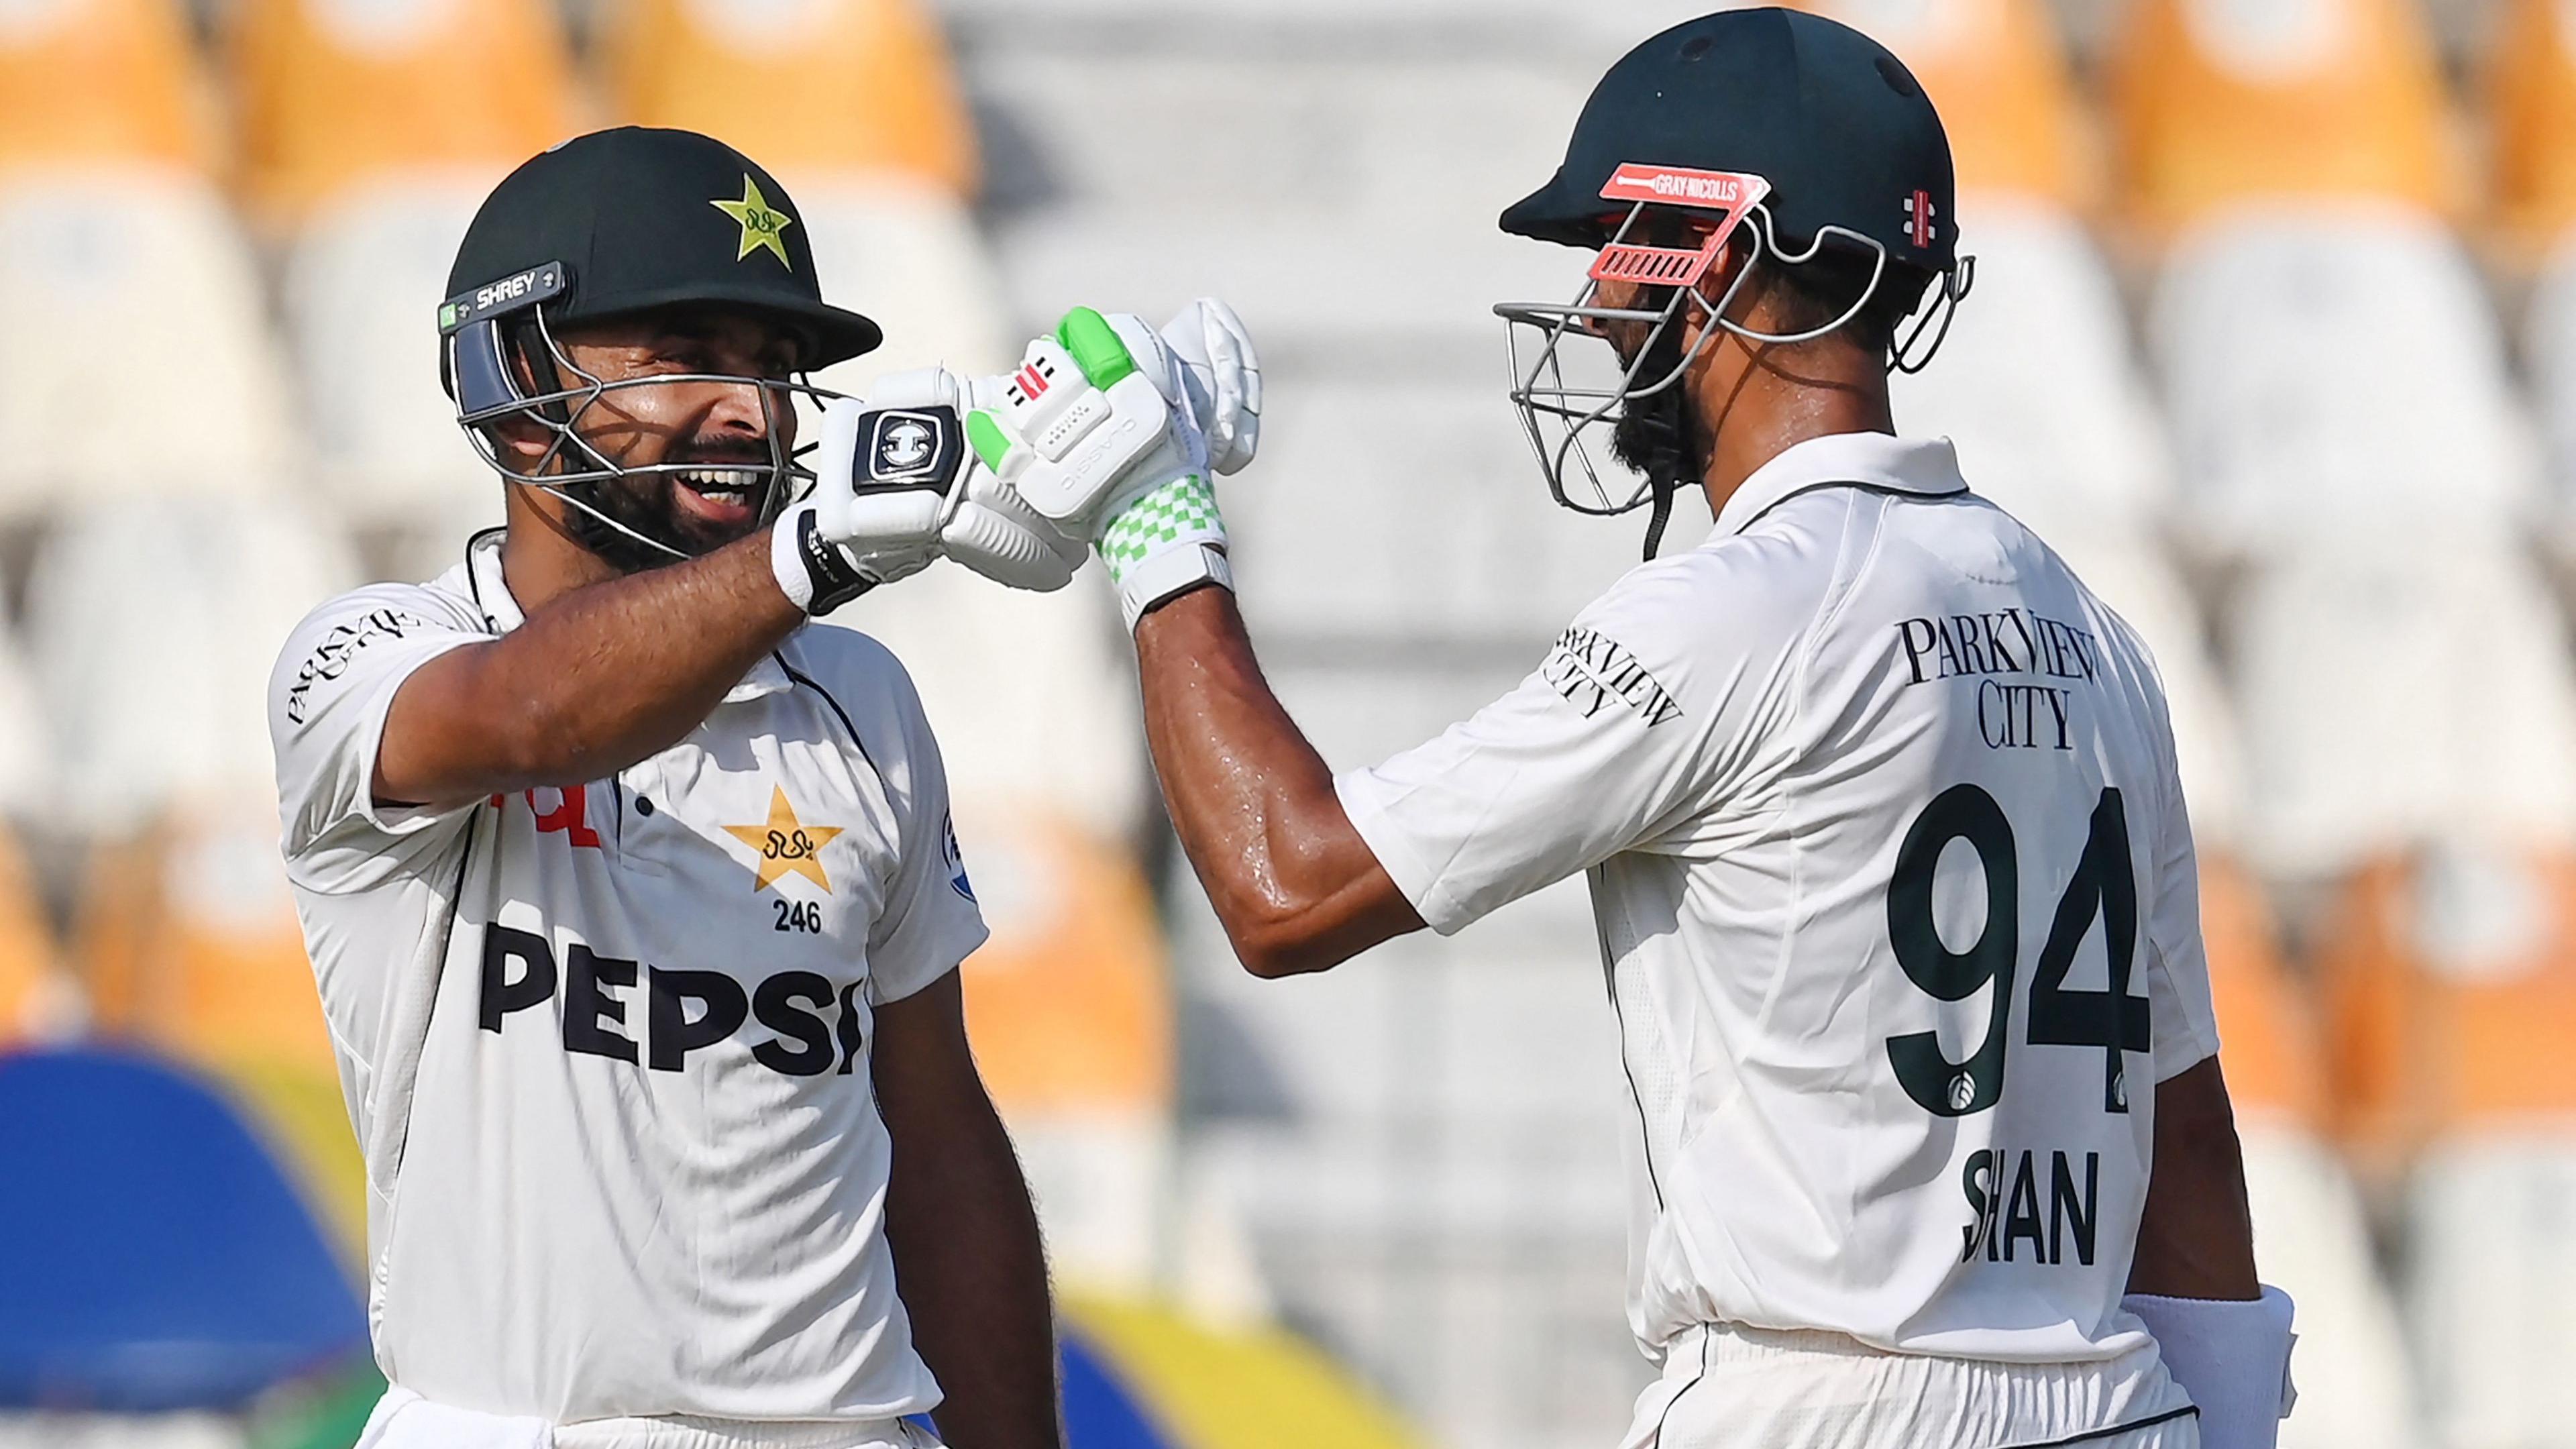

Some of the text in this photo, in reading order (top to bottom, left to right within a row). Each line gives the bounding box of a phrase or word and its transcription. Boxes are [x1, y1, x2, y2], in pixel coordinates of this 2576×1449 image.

[1655, 174, 1739, 201] GRAY-NICOLLS
[476, 271, 536, 311] SHREY
[1061, 417, 1137, 491] CLASSIC
[287, 608, 422, 724] PARKVIE
[1977, 678, 2073, 751] CITY
[773, 899, 821, 934] 246
[1886, 783, 2151, 1118] 94
[478, 921, 864, 1077] PEPSI
[1962, 1149, 2099, 1266] SHAN
